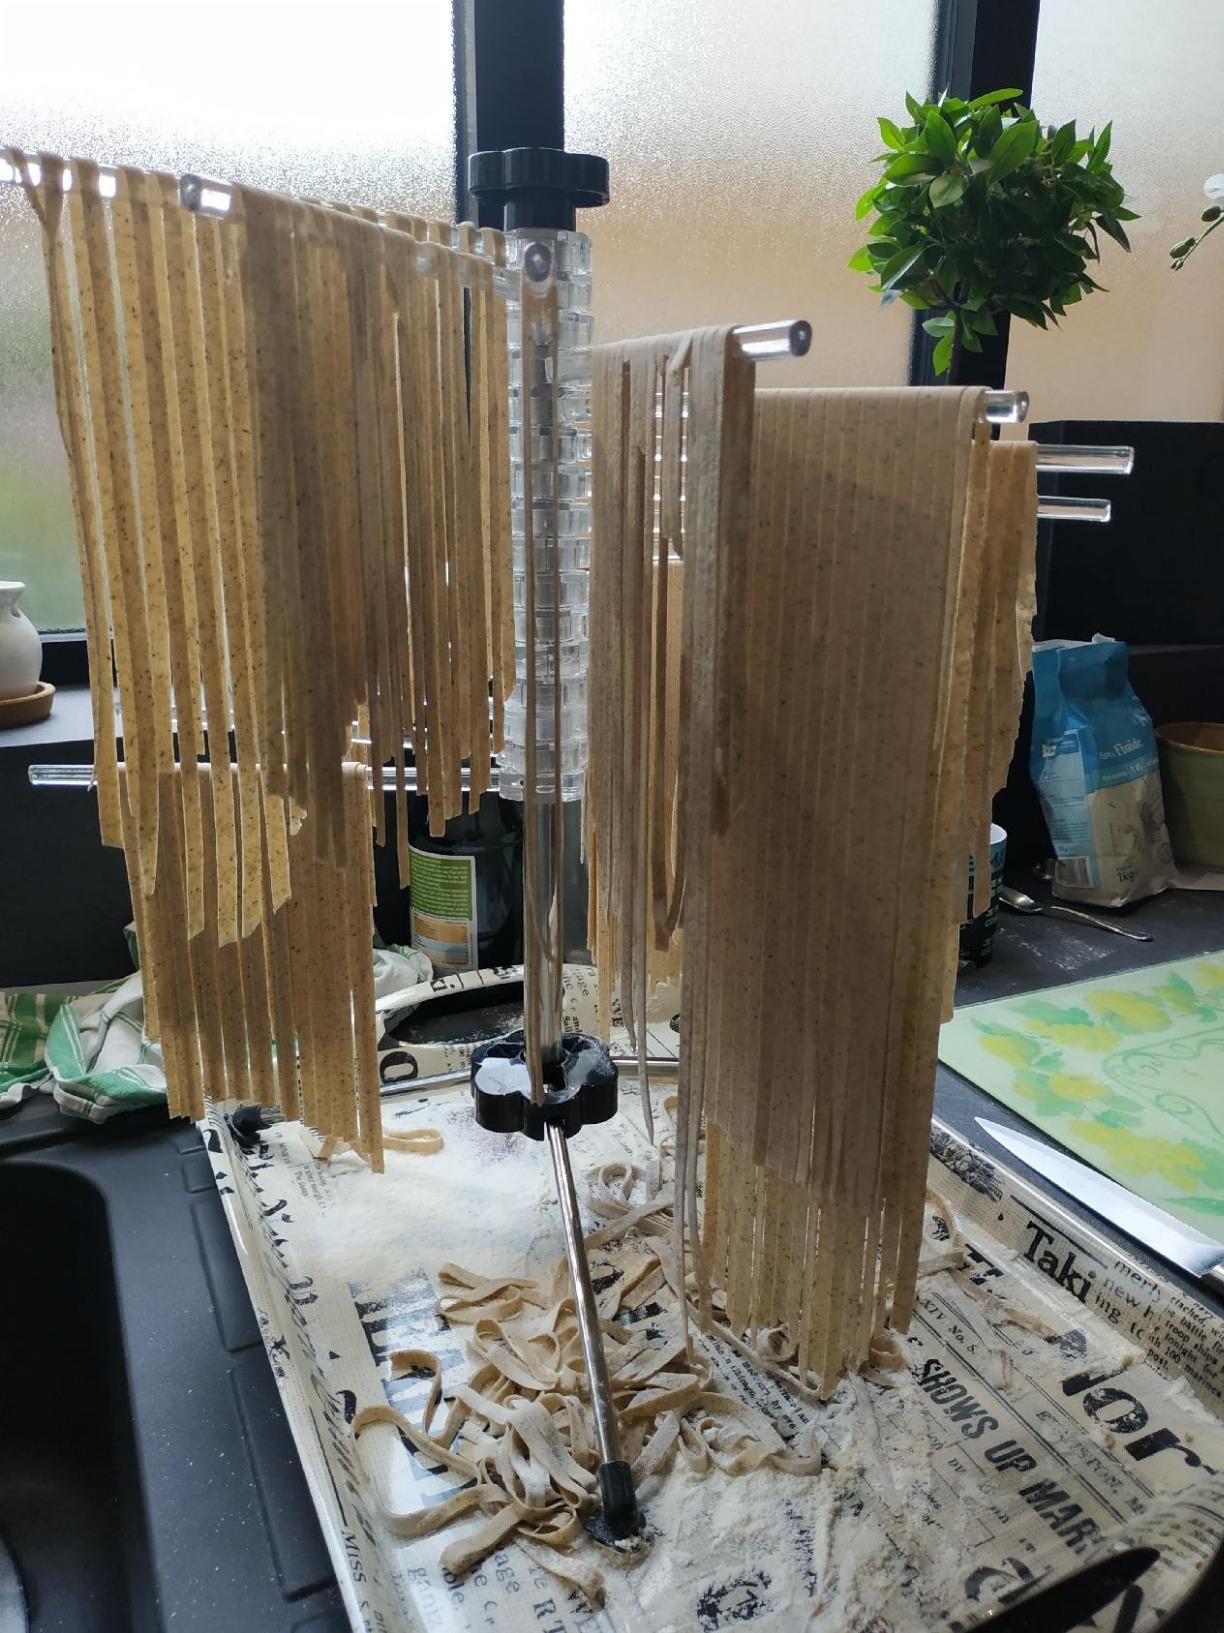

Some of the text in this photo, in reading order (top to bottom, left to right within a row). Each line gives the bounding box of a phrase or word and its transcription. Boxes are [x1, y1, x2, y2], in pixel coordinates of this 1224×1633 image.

[1023, 1220, 1097, 1304] Taki
[1164, 1319, 1190, 1342] troop
[1164, 1332, 1198, 1363] tonight
[984, 1438, 1038, 1473] UP
